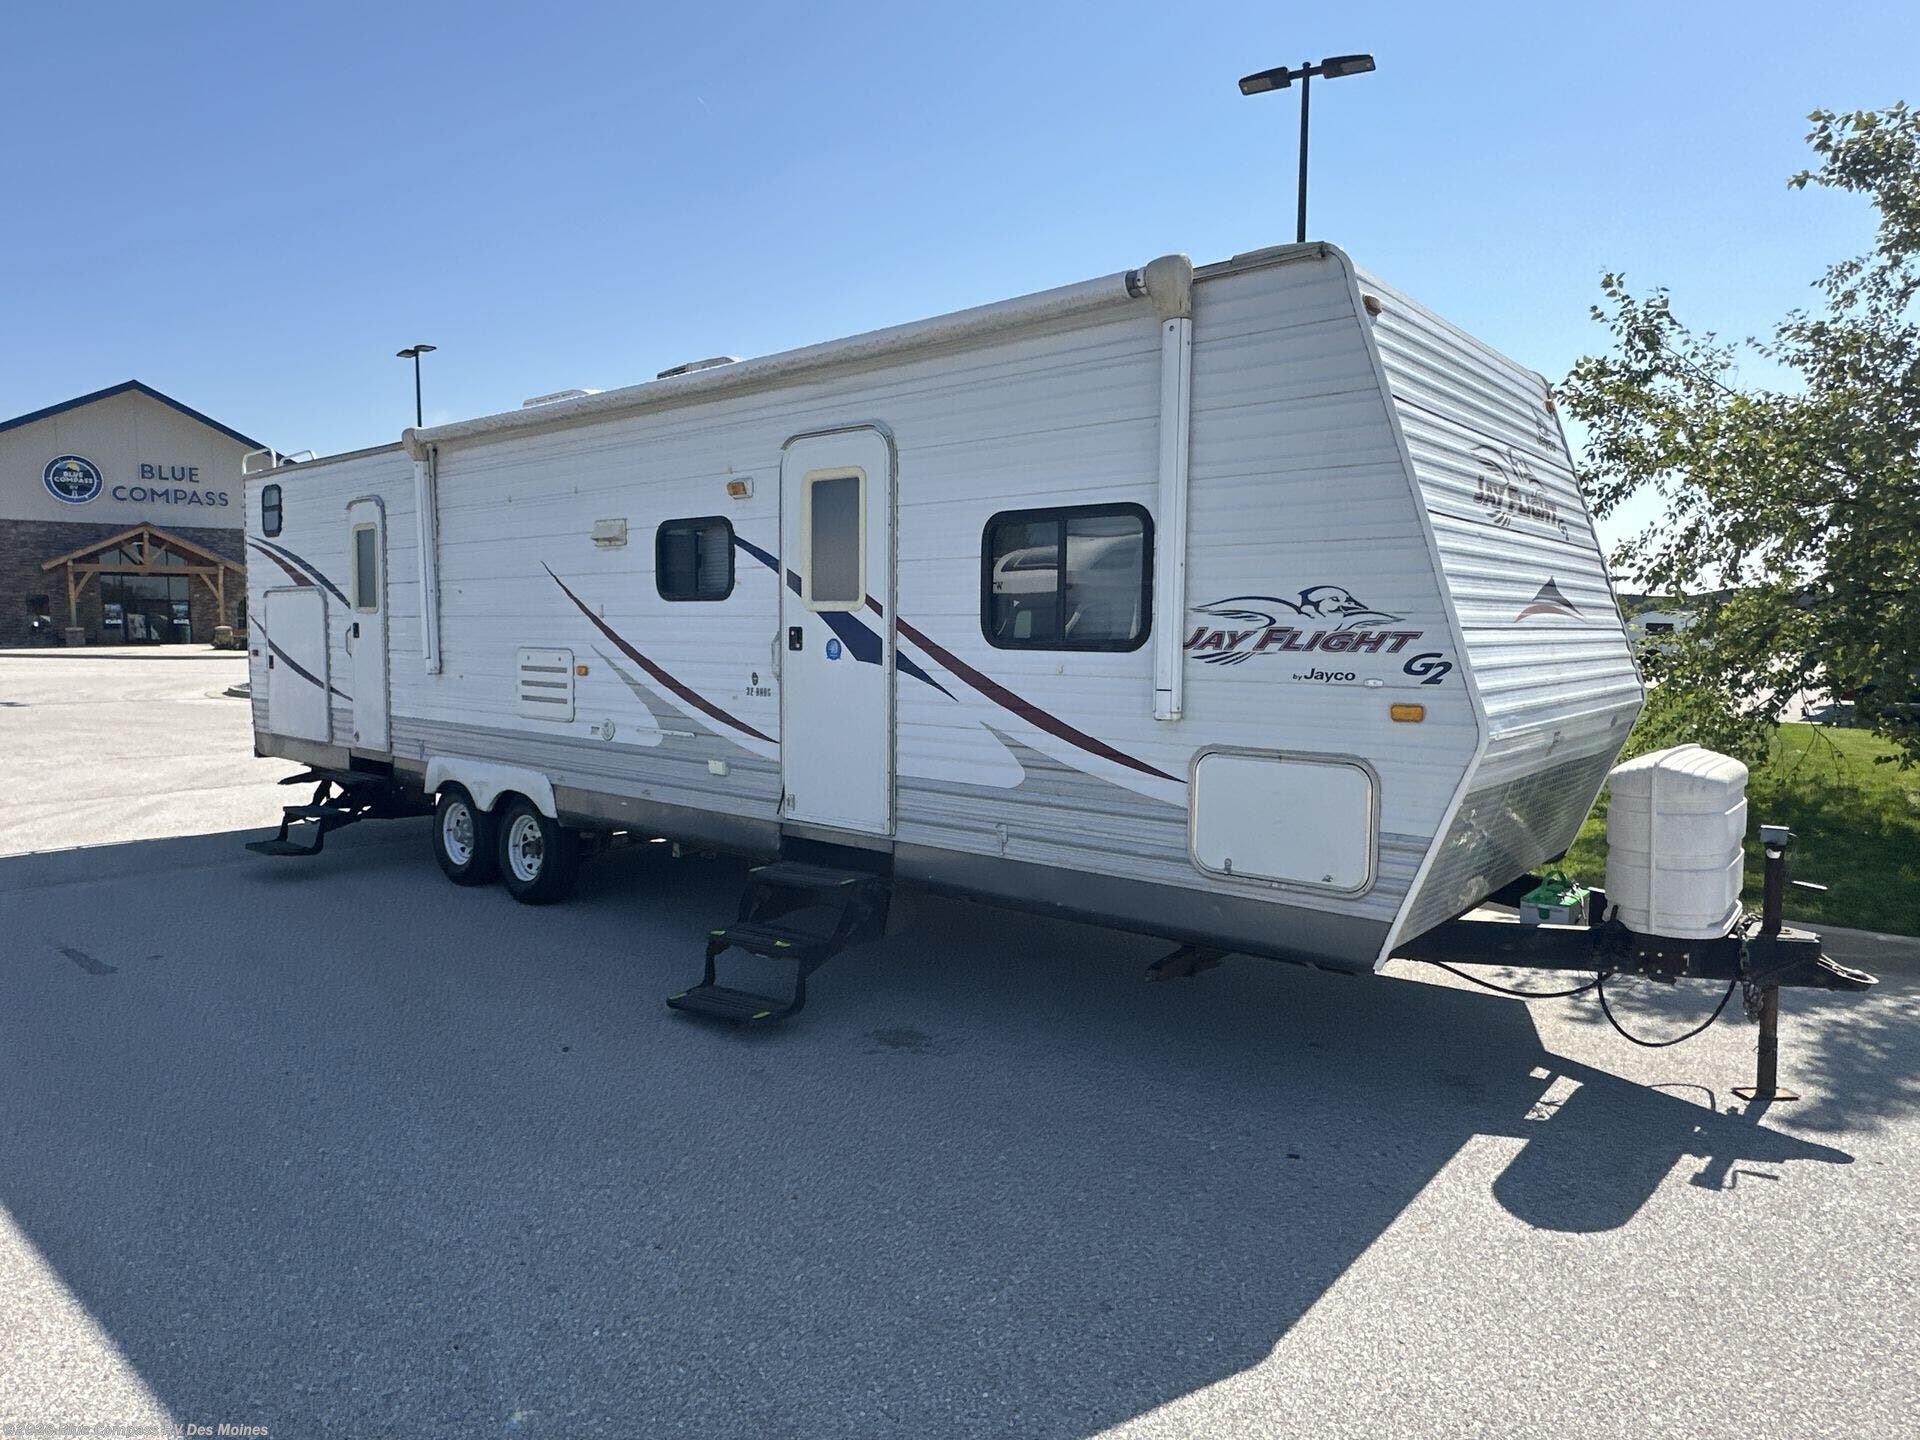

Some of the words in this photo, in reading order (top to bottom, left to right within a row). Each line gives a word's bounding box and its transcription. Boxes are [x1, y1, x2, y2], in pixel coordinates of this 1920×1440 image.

[53, 476, 94, 484] COMPASS
[140, 463, 200, 483] BLUE
[112, 485, 229, 507] COMPASS
[1184, 627, 1260, 651] JAY
[1251, 627, 1424, 653] FLIGHT
[1292, 673, 1302, 681] by
[1303, 668, 1356, 682] Jayco
[1402, 652, 1453, 685] G2
